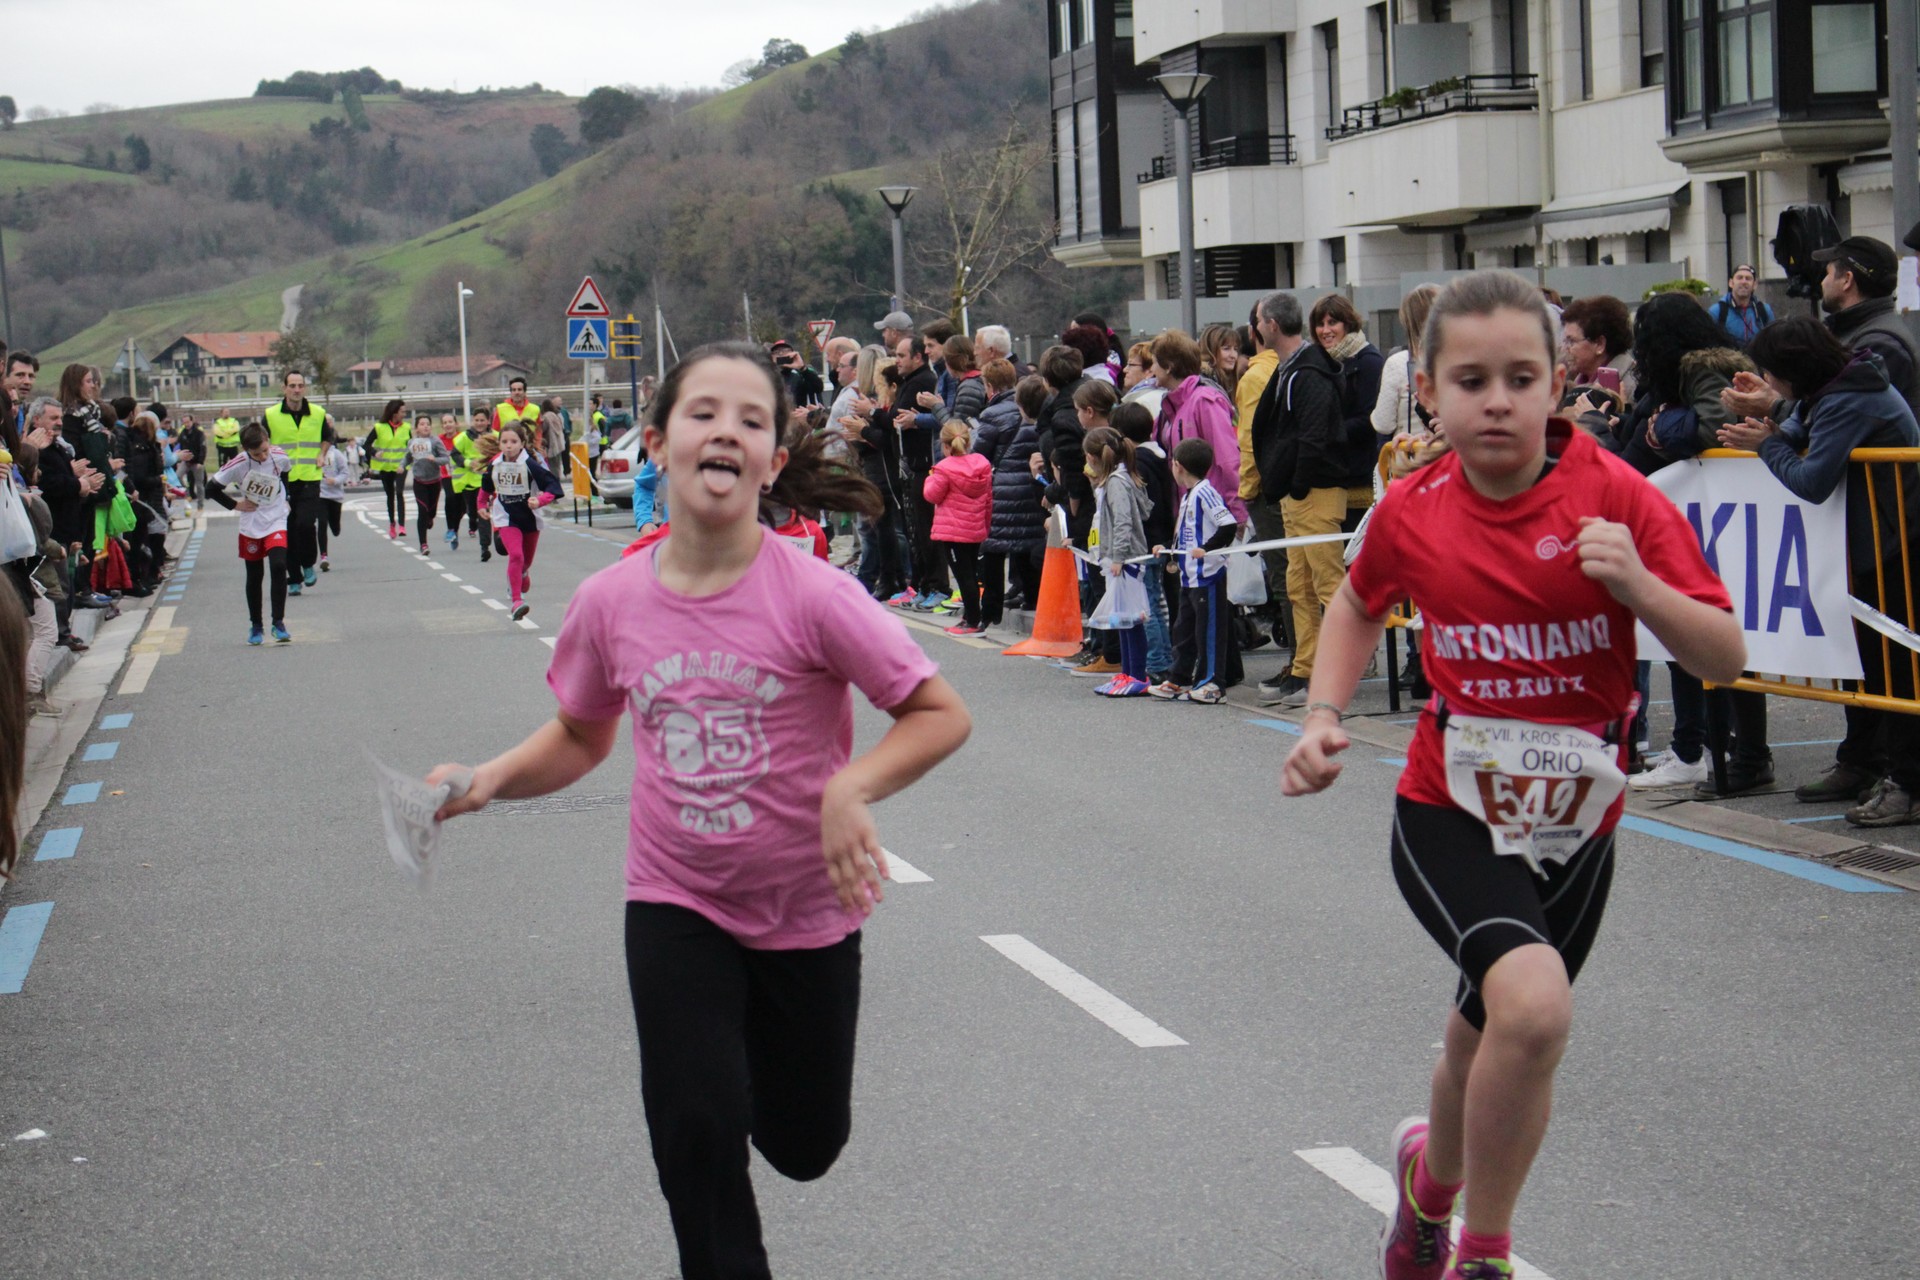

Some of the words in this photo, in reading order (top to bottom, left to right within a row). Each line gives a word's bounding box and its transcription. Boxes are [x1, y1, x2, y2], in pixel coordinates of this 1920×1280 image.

[249, 481, 272, 497] 570
[498, 472, 520, 485] 597
[1461, 675, 1585, 699] ZARAUTZ
[1520, 730, 1561, 746] KROS
[1522, 749, 1583, 773] ORIO
[1491, 774, 1577, 825] 549
[680, 800, 754, 834] CLUB
